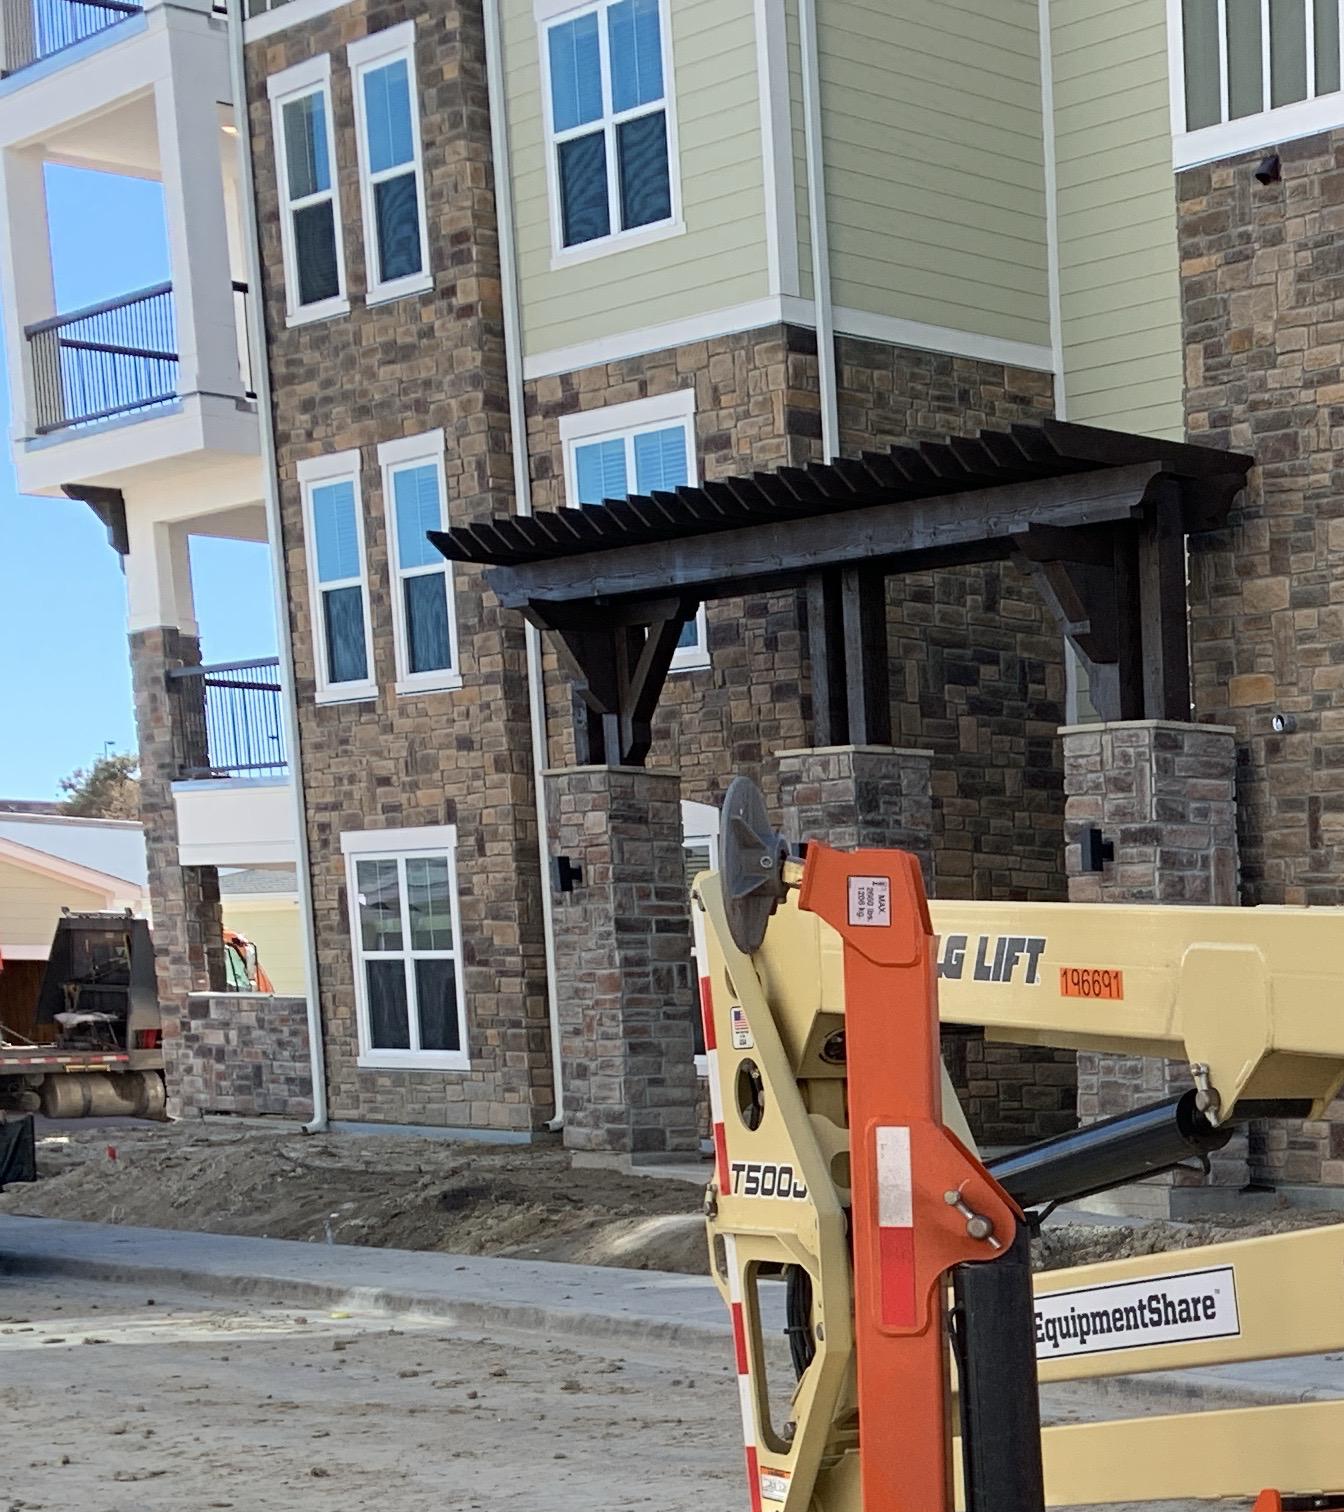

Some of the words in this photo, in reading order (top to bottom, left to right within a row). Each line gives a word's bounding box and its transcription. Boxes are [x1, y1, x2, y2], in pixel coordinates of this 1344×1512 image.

[973, 936, 1046, 984] LIFT
[1061, 968, 1121, 998] 196691
[1034, 1293, 1216, 1349] EquipmentShare
